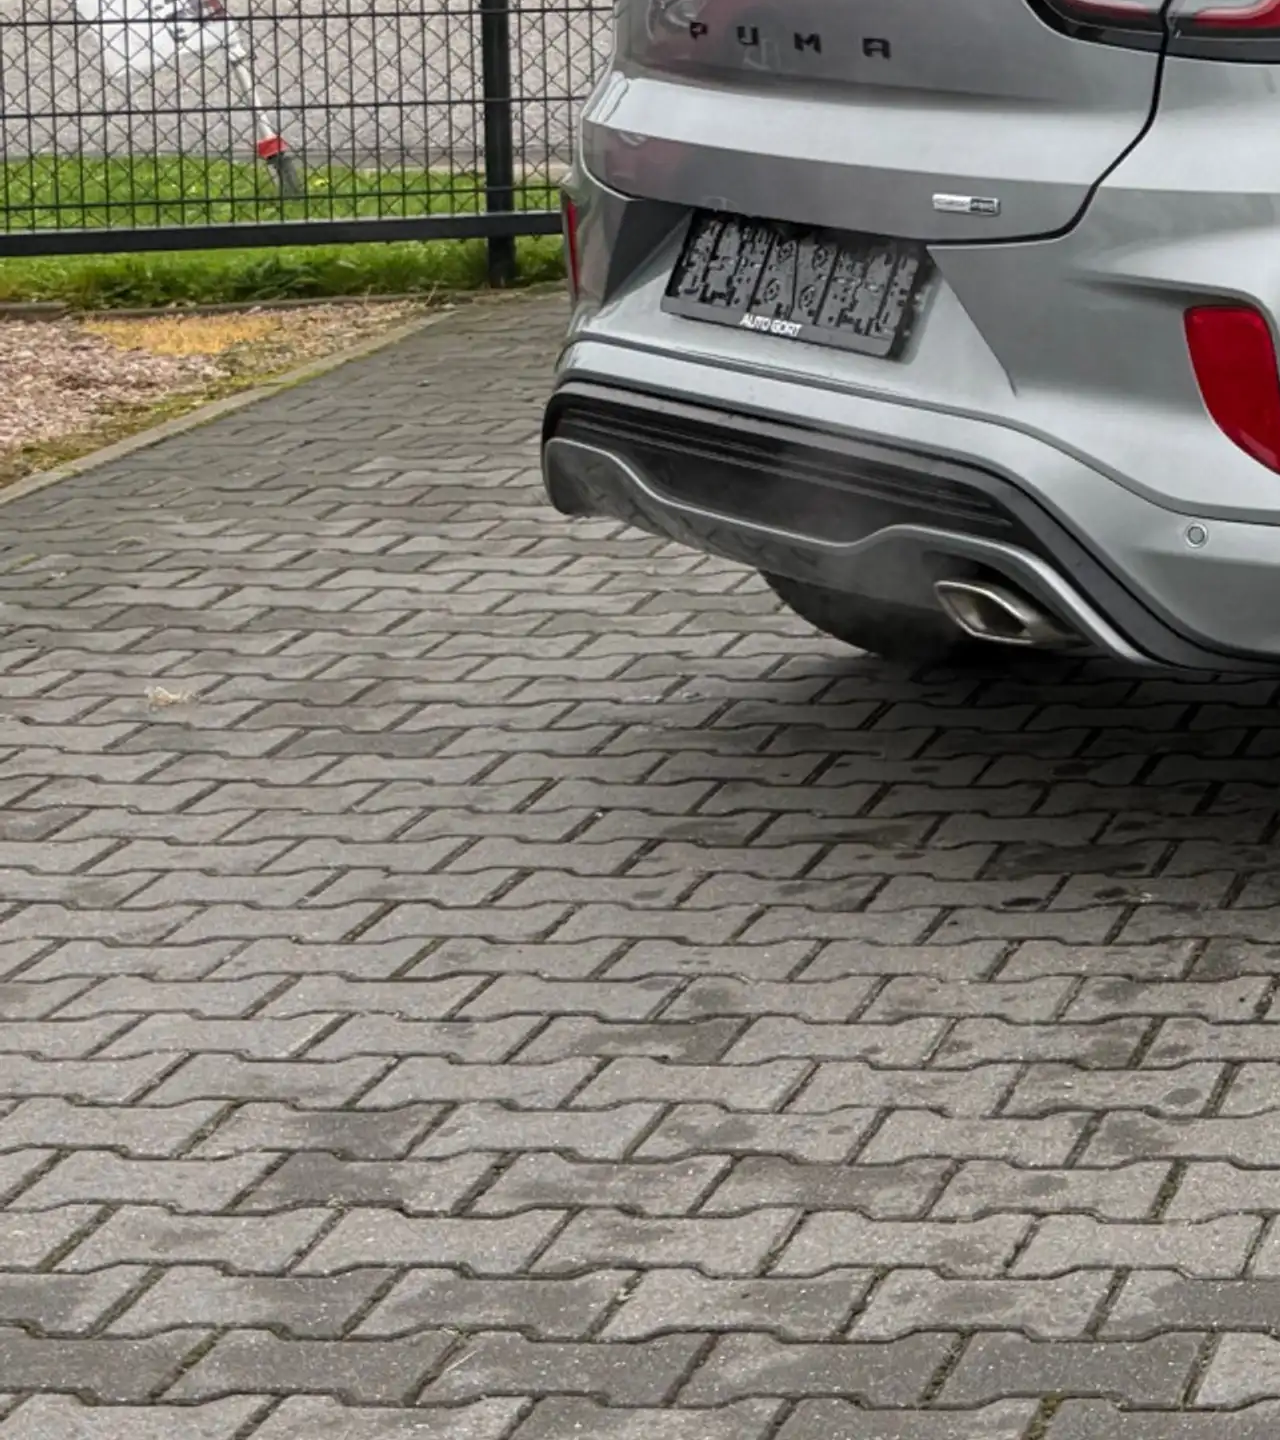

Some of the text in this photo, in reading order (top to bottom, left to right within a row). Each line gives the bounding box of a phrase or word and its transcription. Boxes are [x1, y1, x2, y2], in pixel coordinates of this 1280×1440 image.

[690, 21, 892, 60] PUMA
[740, 313, 803, 337] AUTO GORT
